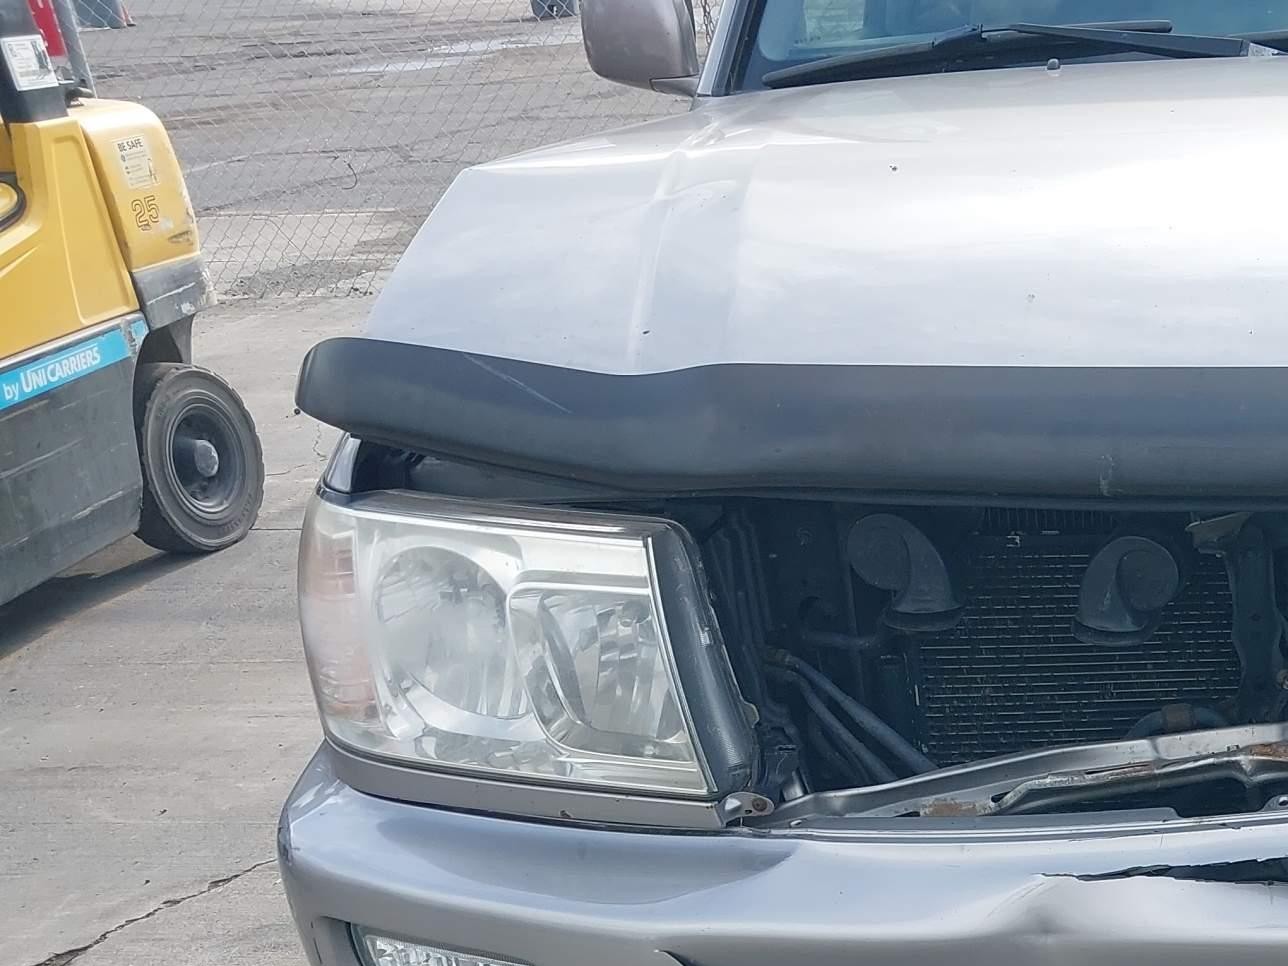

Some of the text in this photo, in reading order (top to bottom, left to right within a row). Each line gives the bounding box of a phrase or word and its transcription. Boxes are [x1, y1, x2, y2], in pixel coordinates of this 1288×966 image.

[117, 139, 144, 152] BE SAFE
[131, 195, 159, 228] 25
[3, 382, 19, 400] by
